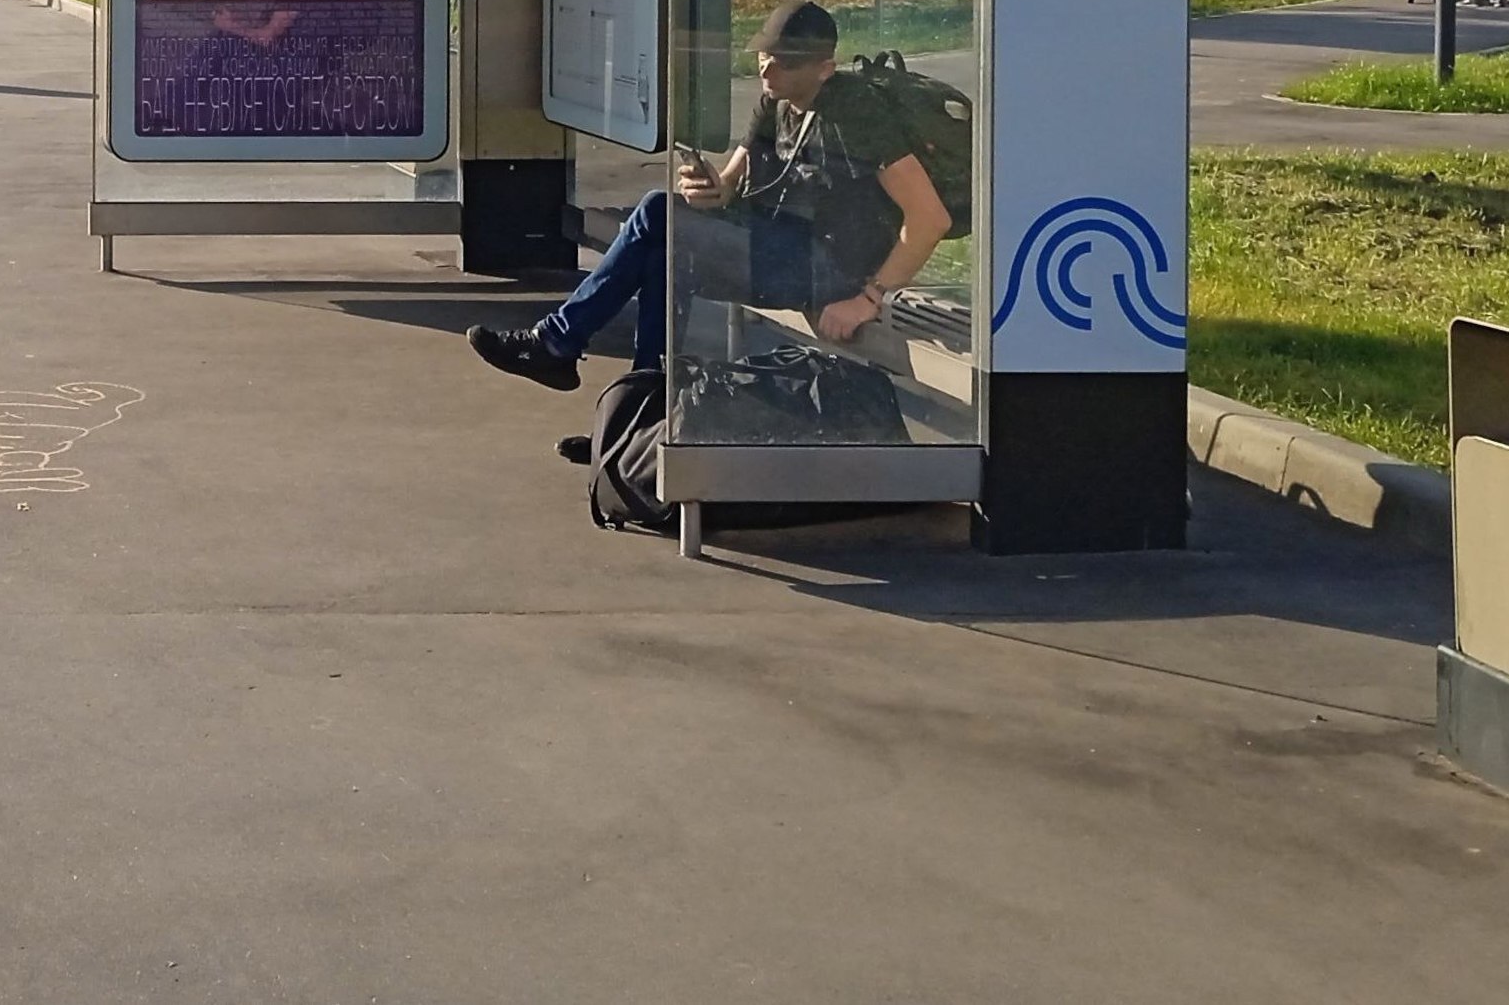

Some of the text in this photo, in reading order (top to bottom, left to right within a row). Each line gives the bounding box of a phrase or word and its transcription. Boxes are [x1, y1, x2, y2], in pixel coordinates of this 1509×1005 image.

[184, 77, 207, 132] НЕ
[210, 77, 295, 131] ЯВЛЯЕТСЯ
[298, 75, 415, 131] ЛЕКАРСТВОМ
